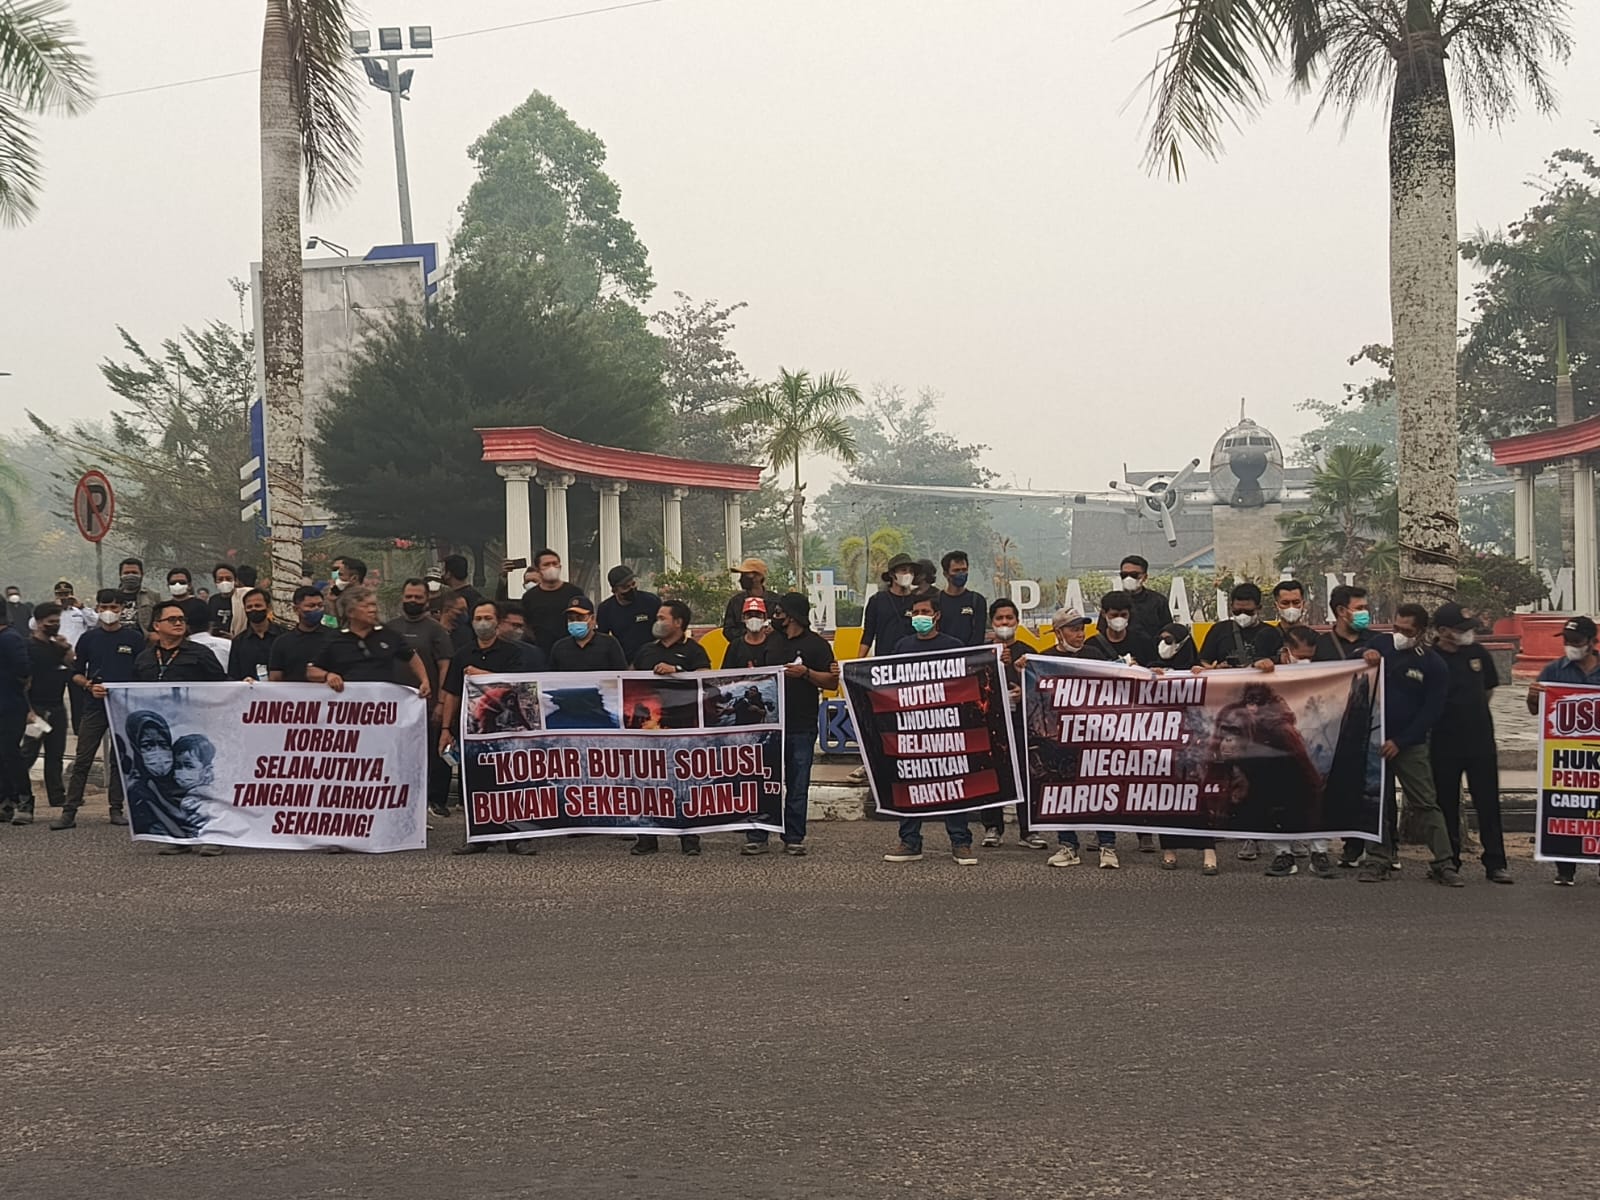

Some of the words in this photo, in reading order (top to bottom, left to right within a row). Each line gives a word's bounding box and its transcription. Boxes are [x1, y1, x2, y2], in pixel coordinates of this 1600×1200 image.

[870, 657, 967, 686] SELAMATKAN
[898, 683, 946, 708] HUTAN
[1138, 678, 1203, 706] KAMI
[242, 701, 319, 724] JANGAN
[327, 701, 397, 725] TUNGGU
[896, 707, 960, 731] LINDUNGI
[1060, 711, 1190, 744] TERBAKAR,
[284, 729, 360, 753] KORBAN
[897, 732, 966, 754] RELAWAN
[254, 755, 390, 784] SELANJUTNYA,
[587, 748, 667, 781] BUTUH
[674, 743, 772, 780] SOLUSI,
[896, 755, 970, 780] SEHATKAN
[1080, 749, 1173, 777] NEGARA
[232, 784, 314, 808] TANGANI
[317, 784, 409, 809] KARHUTLA
[472, 789, 559, 825] BUKAN
[564, 785, 677, 818] SEKEDAR
[908, 780, 965, 805] RAKYAT
[1040, 785, 1120, 815] HARUS
[1551, 793, 1598, 809] CABUT
[271, 811, 374, 838] SEKARANG!
